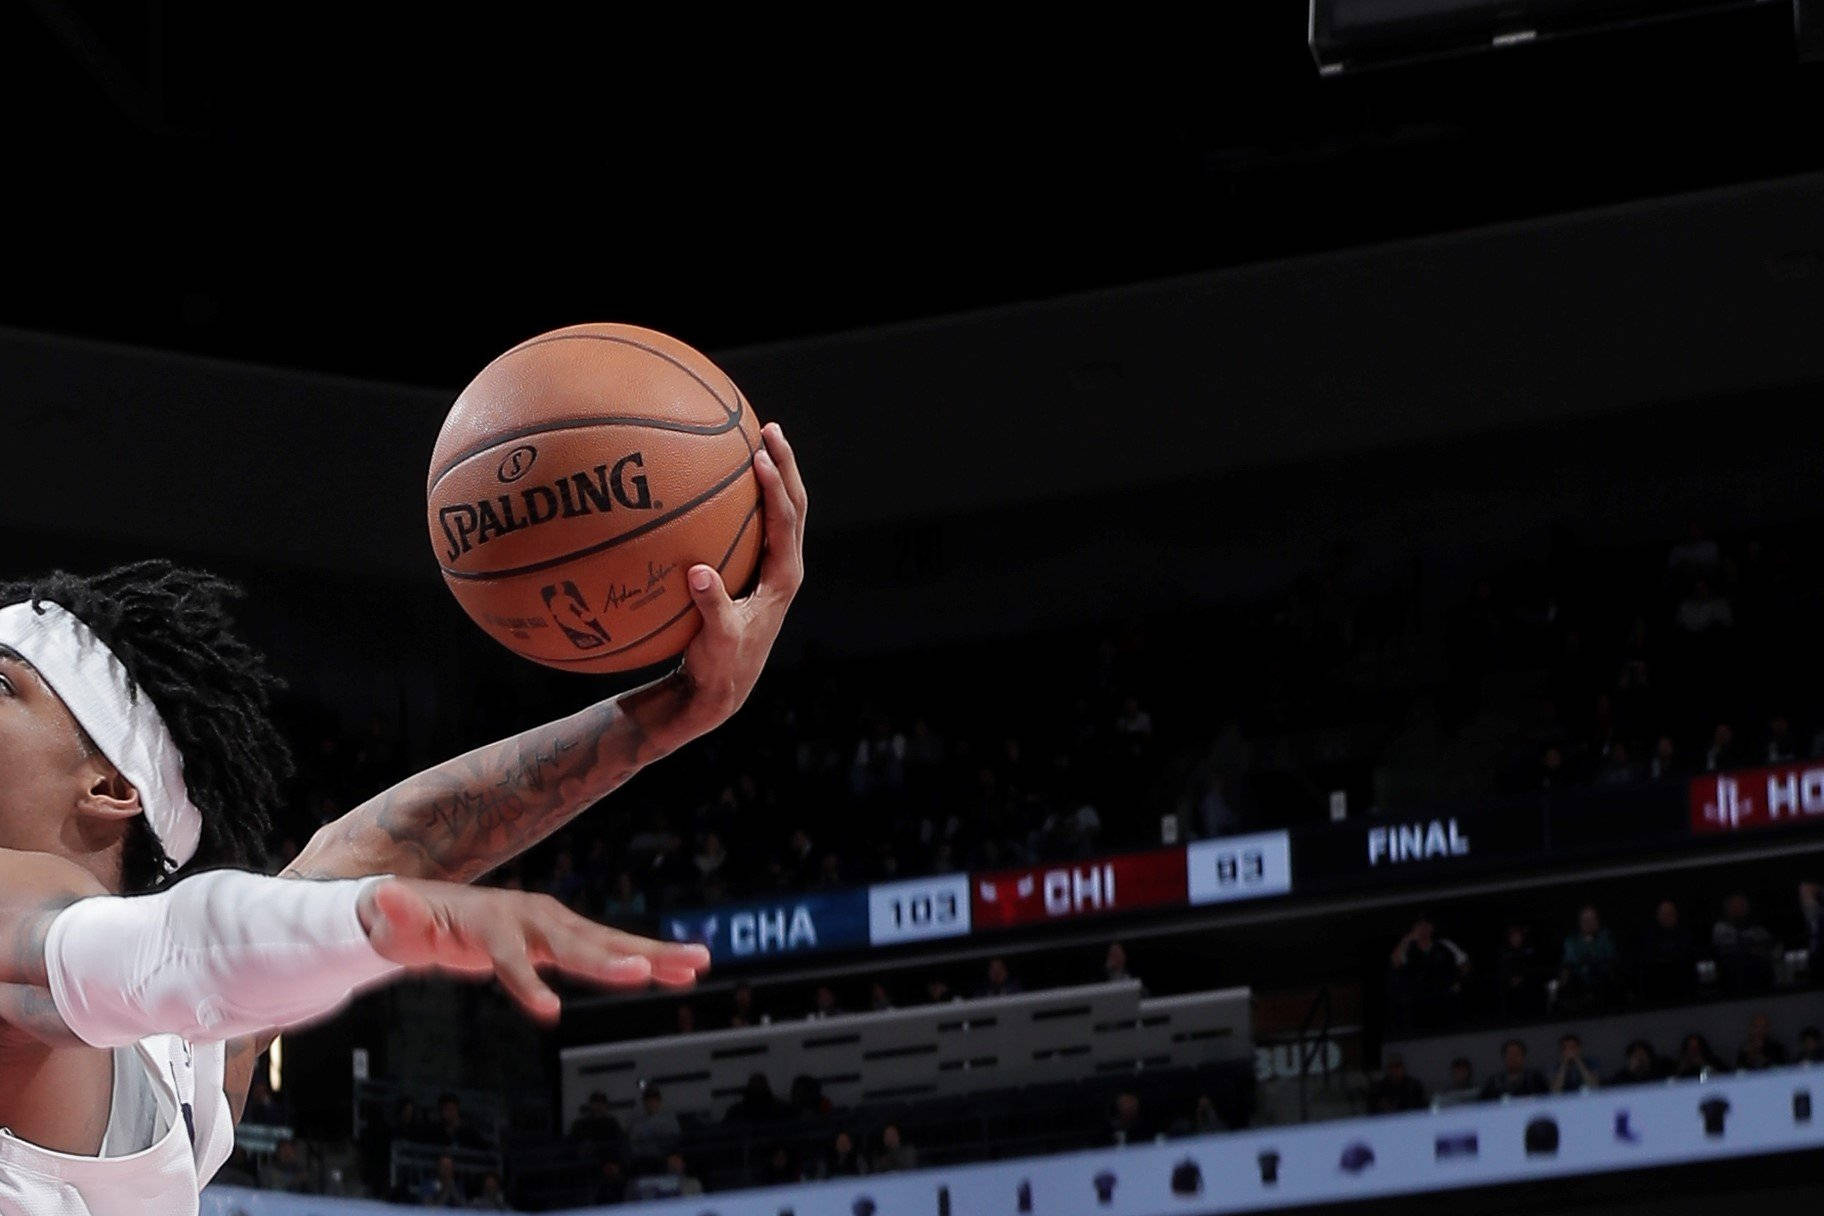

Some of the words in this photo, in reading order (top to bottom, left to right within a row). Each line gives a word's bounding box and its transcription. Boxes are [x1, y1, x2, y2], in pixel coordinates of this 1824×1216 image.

[439, 452, 653, 562] SPALDING
[730, 905, 817, 956] CHA
[891, 893, 957, 929] 103
[1044, 863, 1115, 916] CHI
[1369, 817, 1469, 866] FINAL
